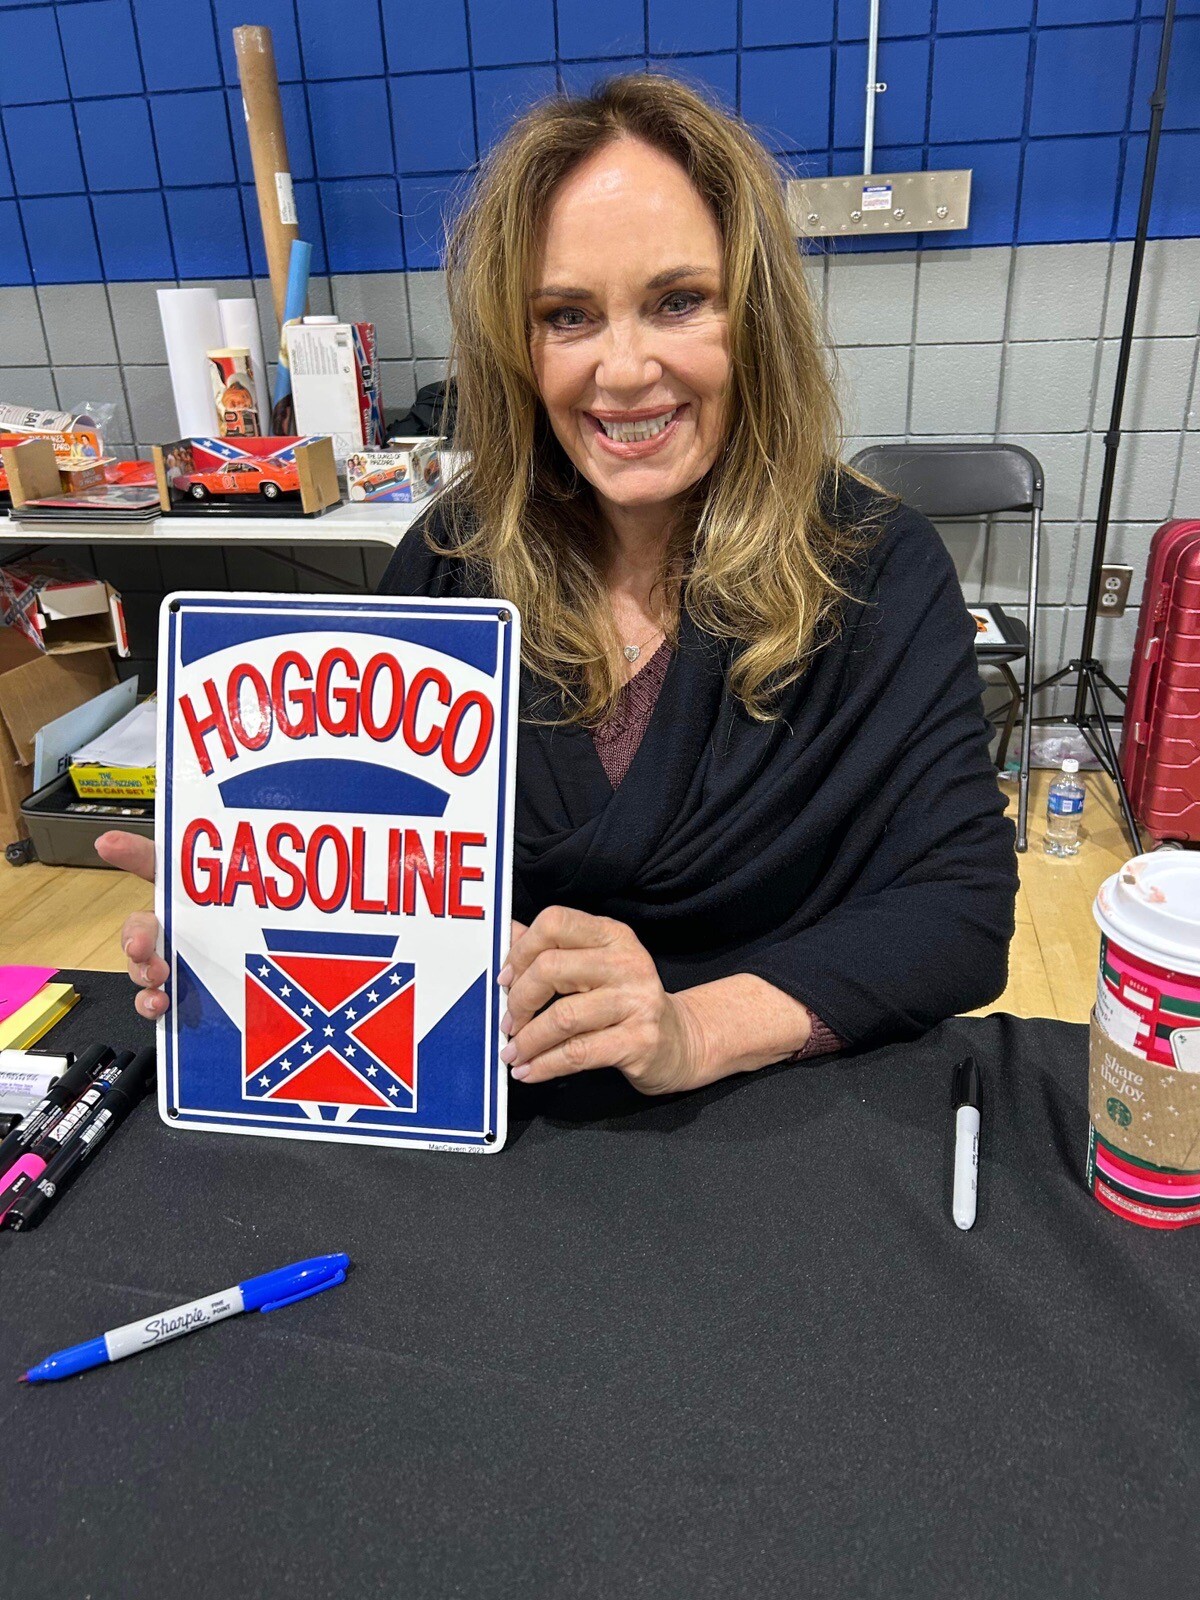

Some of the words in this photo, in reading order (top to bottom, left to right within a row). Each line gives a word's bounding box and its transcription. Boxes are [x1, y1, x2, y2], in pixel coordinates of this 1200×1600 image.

[178, 647, 496, 777] HOGGOCO
[181, 817, 488, 921] GASOLINE
[1100, 1064, 1120, 1088] the
[1116, 1080, 1146, 1103] joy.
[468, 1146, 485, 1155] 2023
